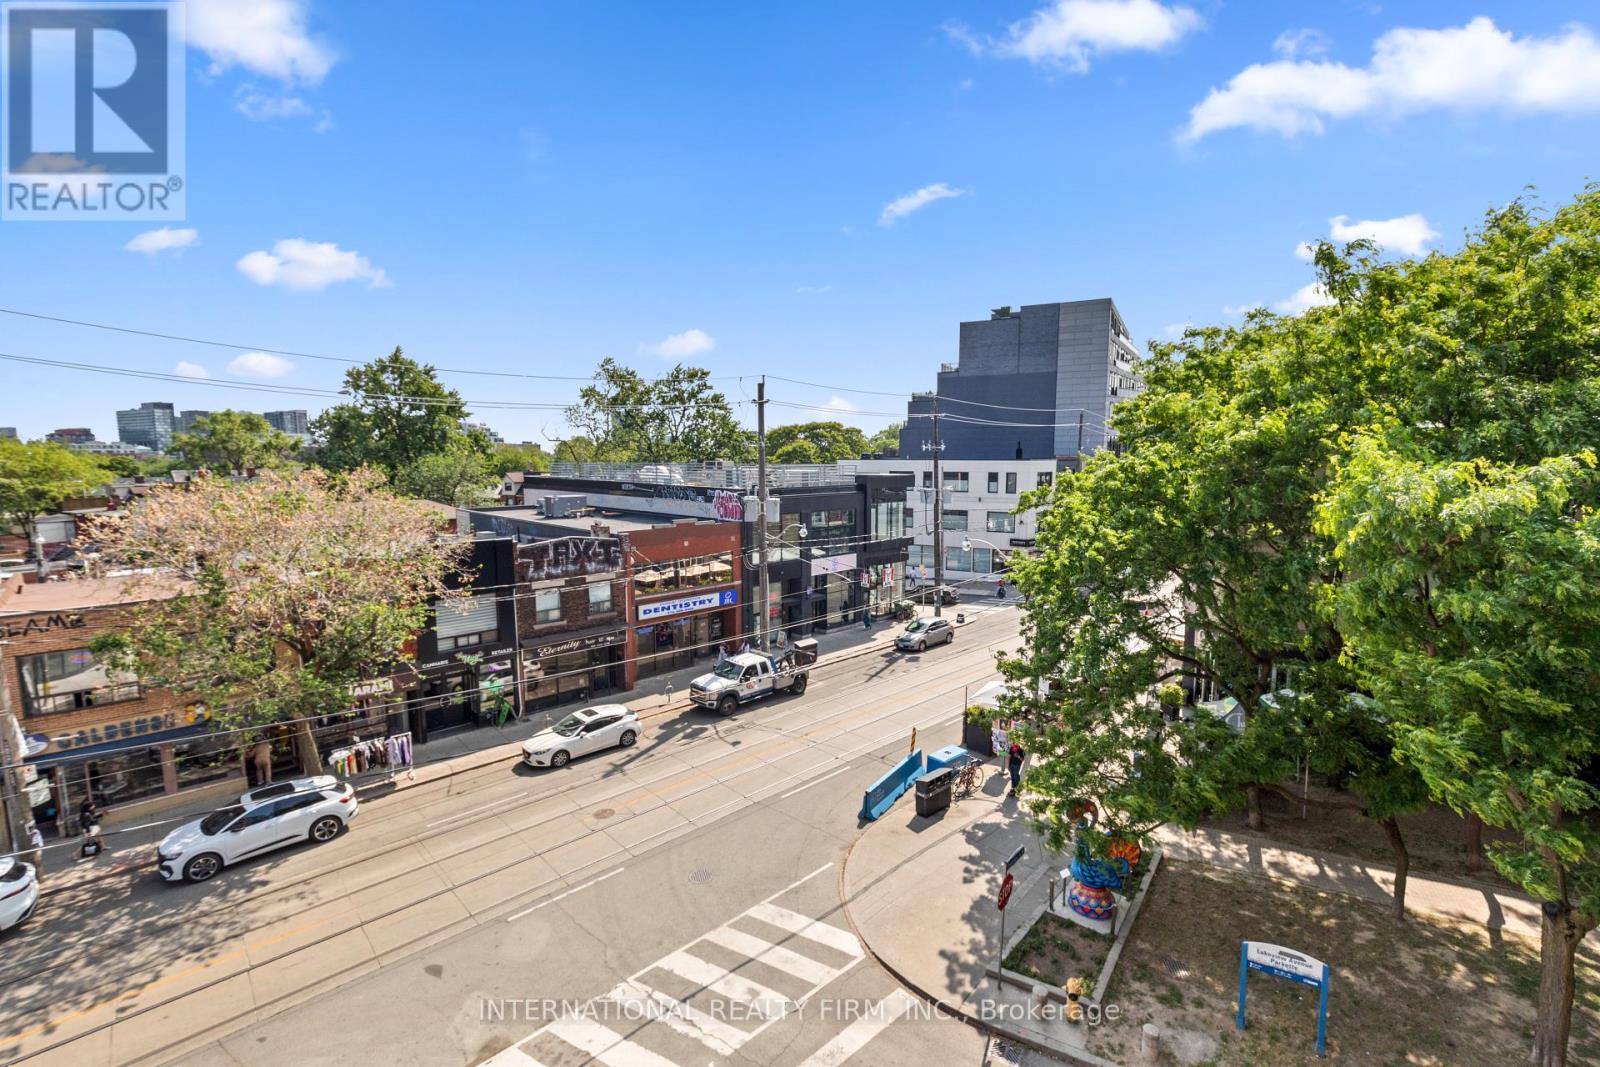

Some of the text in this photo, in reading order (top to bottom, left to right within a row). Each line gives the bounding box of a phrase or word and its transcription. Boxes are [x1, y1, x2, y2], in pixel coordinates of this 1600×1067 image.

[643, 598, 713, 615] DENTISTRY
[537, 640, 581, 657] Eternity
[1256, 949, 1313, 969] Lakeview Avenue
[1270, 958, 1298, 970] Parkette
